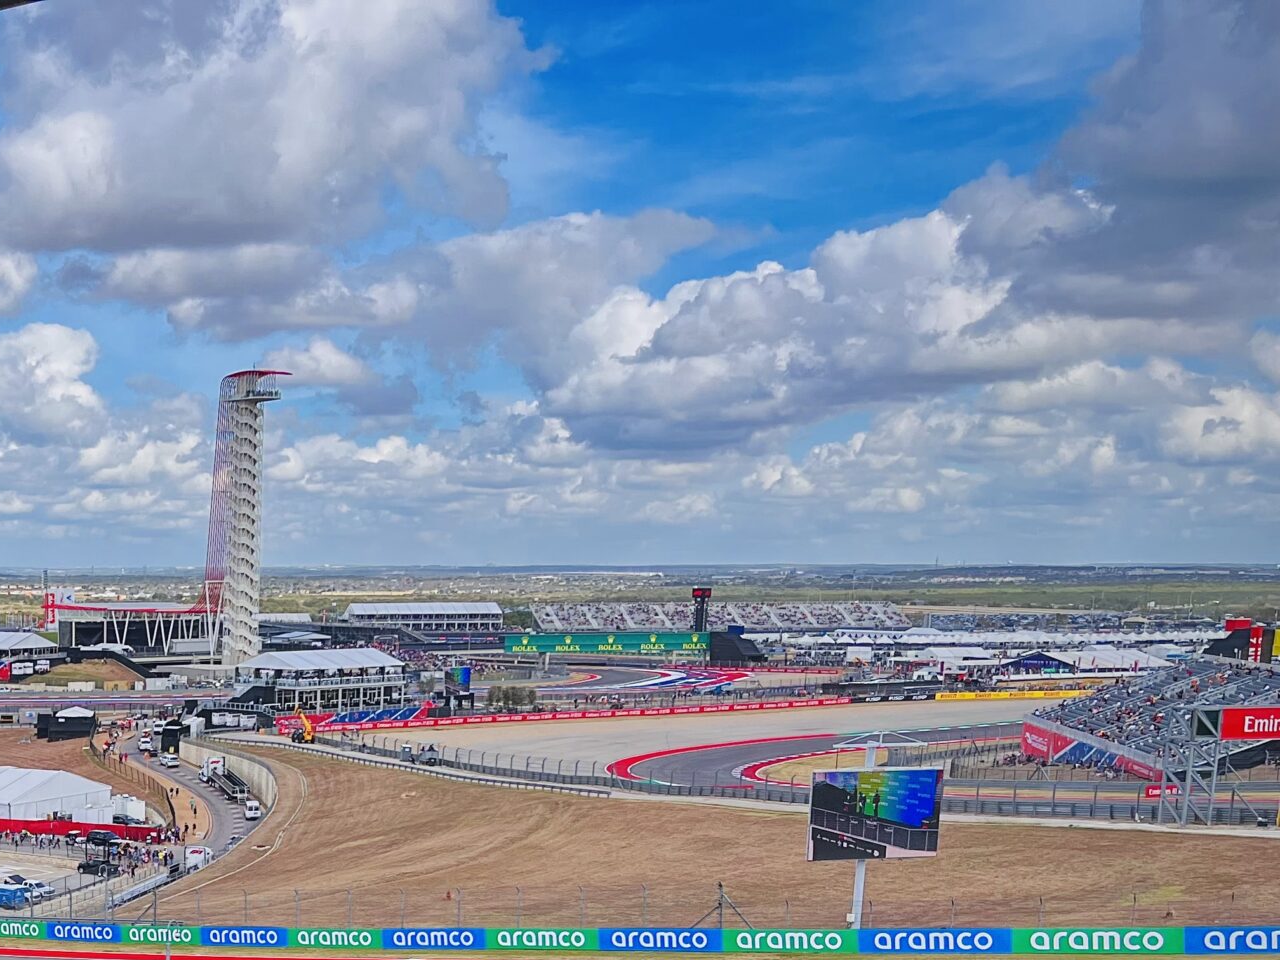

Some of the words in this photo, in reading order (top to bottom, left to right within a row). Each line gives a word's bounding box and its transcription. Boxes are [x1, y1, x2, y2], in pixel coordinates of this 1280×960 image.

[54, 925, 112, 940] aramco
[129, 927, 192, 942] aramco
[210, 929, 277, 944] aramco
[297, 931, 371, 946] aramco
[393, 930, 474, 946] aramco
[497, 931, 585, 948] aramco
[611, 931, 707, 949] aramco
[736, 931, 842, 950] aramco
[875, 932, 992, 950] aramco
[1030, 931, 1163, 951] aramco
